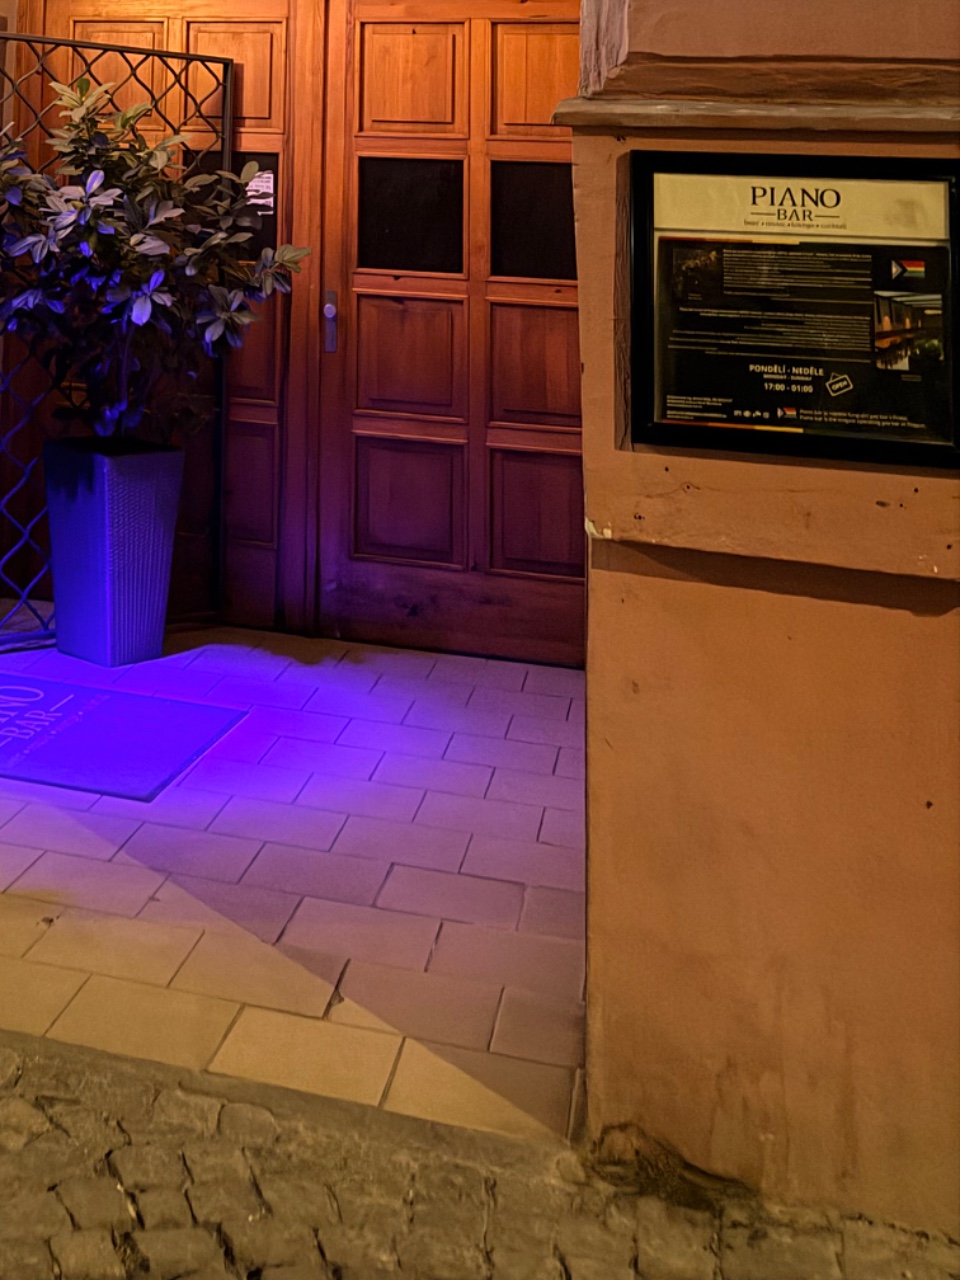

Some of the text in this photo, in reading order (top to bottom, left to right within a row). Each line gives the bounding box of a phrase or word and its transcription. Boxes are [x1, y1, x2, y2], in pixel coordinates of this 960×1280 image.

[751, 186, 841, 208] PIANO
[777, 208, 813, 221] BAR
[764, 383, 785, 391] 17:00
[791, 385, 813, 393] 01:00
